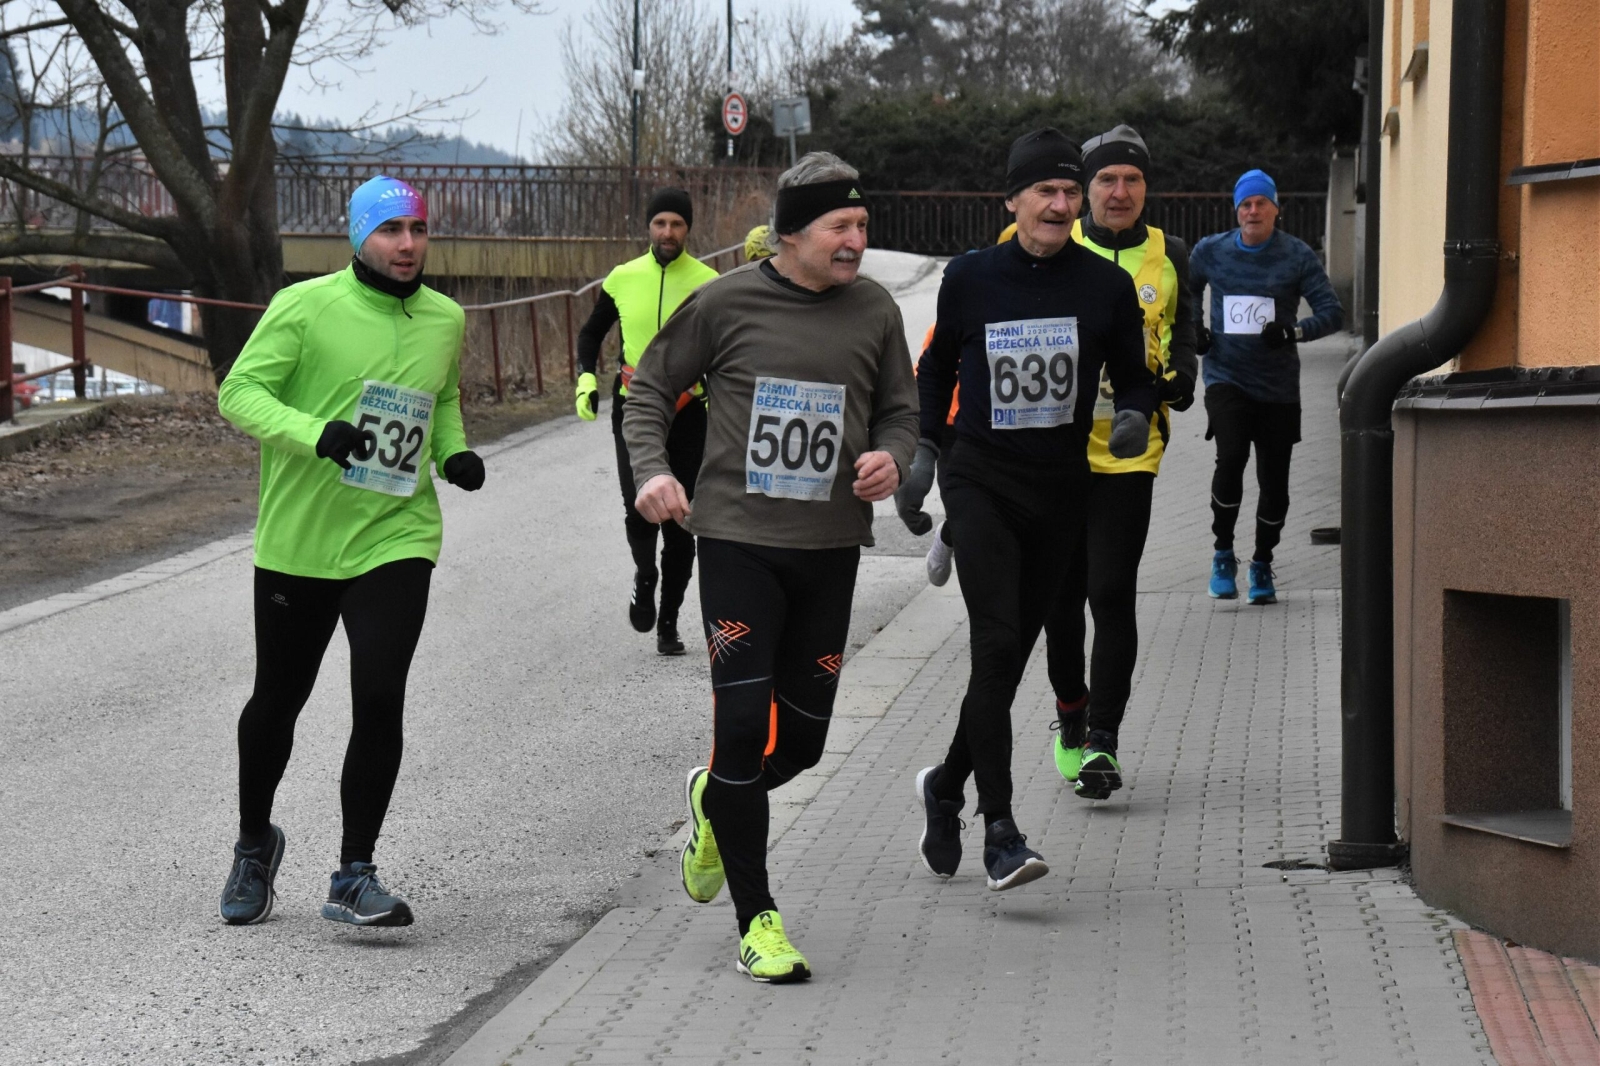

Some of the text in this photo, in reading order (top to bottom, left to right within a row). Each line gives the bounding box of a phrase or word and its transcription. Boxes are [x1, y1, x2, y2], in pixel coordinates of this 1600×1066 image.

[1230, 301, 1267, 325] 616
[988, 324, 1024, 338] ZIMNÍ
[1027, 327, 1072, 335] 2020-2021
[988, 335, 1041, 351] BĚŽECKÁ
[1046, 335, 1073, 346] LIGA
[994, 352, 1074, 404] 639
[365, 385, 398, 399] ZIMNÍ
[758, 382, 798, 396] ZIMNÍ
[800, 392, 843, 401] 2017-2018
[360, 395, 408, 416] BĚŽECKÁ
[412, 408, 429, 421] LIGA
[756, 395, 811, 411] BĚŽECKÁ
[816, 402, 840, 414] LIGA
[350, 413, 424, 474] 532
[750, 414, 838, 473] 506
